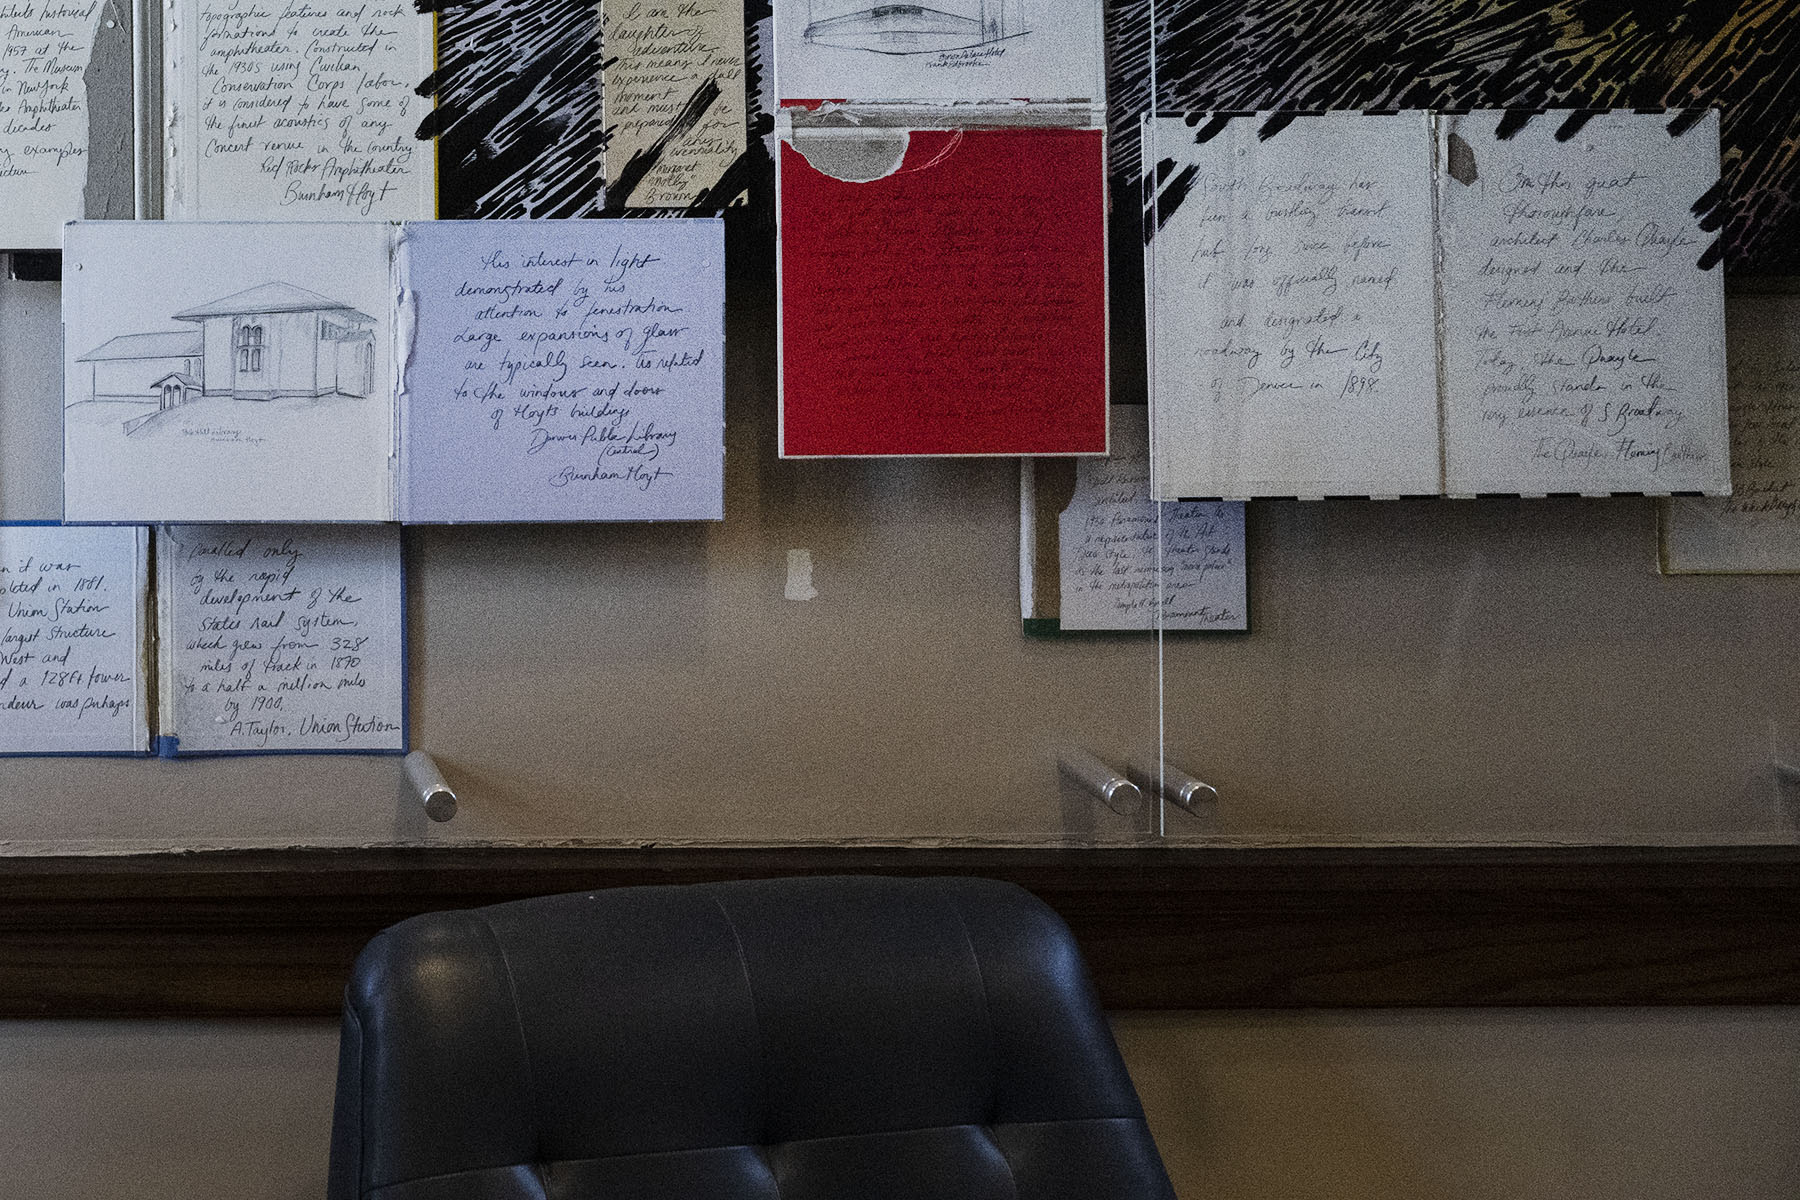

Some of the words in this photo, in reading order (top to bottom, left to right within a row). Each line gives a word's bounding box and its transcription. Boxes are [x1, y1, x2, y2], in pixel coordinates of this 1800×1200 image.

[307, 77, 345, 100] Corps
[280, 180, 347, 206] Burnham
[347, 182, 397, 216] Hoyt
[522, 252, 581, 268] interest
[587, 255, 600, 267] in
[610, 244, 661, 282] light
[455, 278, 564, 303] demonstrated
[574, 280, 589, 307] by
[474, 306, 542, 320] attention
[1305, 334, 1348, 359] the
[592, 382, 618, 400] and
[570, 403, 631, 426] buildings
[626, 422, 677, 446] Library
[549, 465, 627, 487] Burnham
[627, 466, 673, 491] Hoyt
[19, 557, 33, 573] it
[263, 539, 302, 567] only
[48, 582, 60, 592] in
[74, 576, 108, 592] 1881.
[214, 569, 235, 584] the
[249, 566, 296, 593] rapid
[8, 602, 48, 618] Union
[49, 598, 110, 621] Station
[200, 587, 301, 615] development
[309, 591, 322, 608] of
[329, 586, 361, 603] the
[250, 611, 285, 629] rail
[1, 627, 40, 652] largest
[230, 640, 262, 660] grew
[271, 636, 319, 664] from
[330, 637, 369, 650] 328
[0, 651, 35, 665] West
[42, 646, 71, 664] and
[20, 677, 27, 686] a
[87, 666, 130, 689] tower
[200, 659, 232, 672] miles
[242, 658, 255, 682] of
[264, 657, 305, 674] track
[307, 658, 317, 670] in
[331, 656, 361, 669] 1870
[217, 680, 249, 692] half
[278, 675, 331, 693] million
[78, 698, 130, 719] perhaps
[225, 697, 240, 721] by
[300, 714, 341, 736] Union
[339, 713, 400, 742] Station
